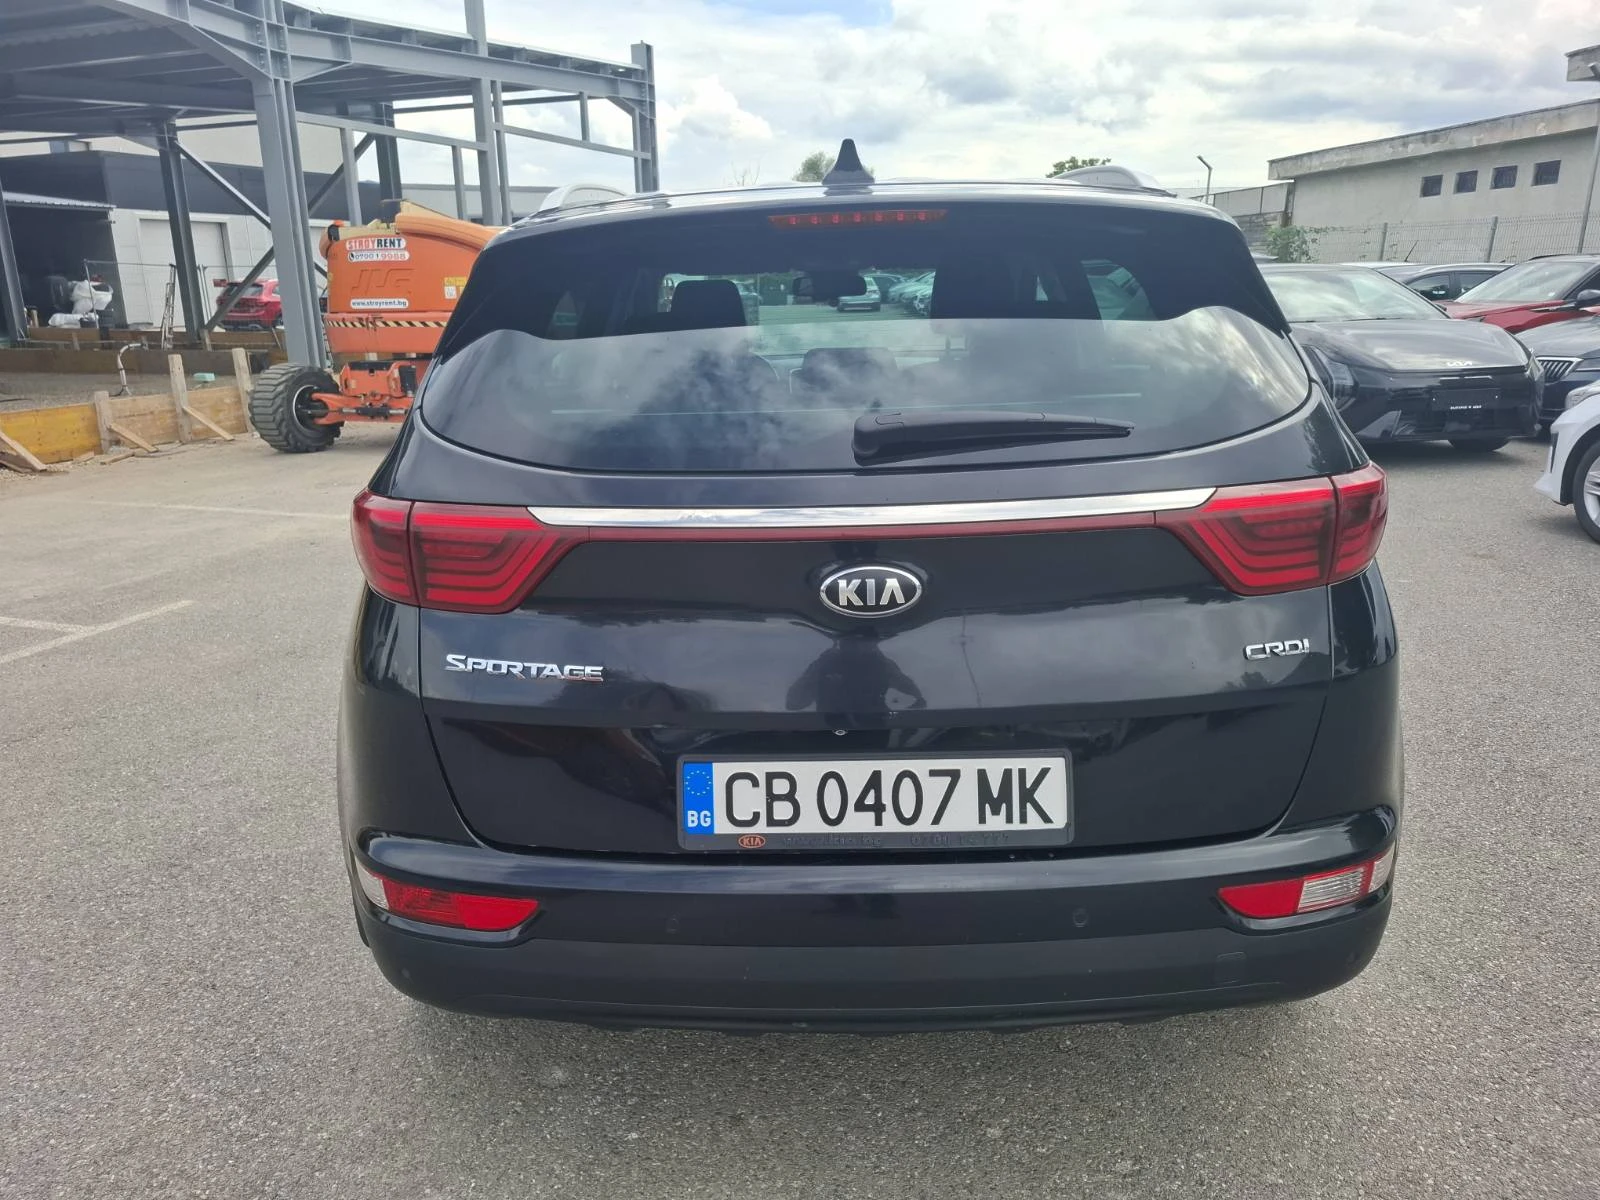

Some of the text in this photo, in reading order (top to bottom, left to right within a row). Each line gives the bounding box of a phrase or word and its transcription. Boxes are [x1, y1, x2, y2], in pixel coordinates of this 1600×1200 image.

[348, 238, 402, 250] STROYRENT
[838, 578, 906, 606] KIA
[725, 767, 1054, 828] CB 0407 MK
[687, 810, 712, 828] BG
[743, 837, 762, 846] KIA
